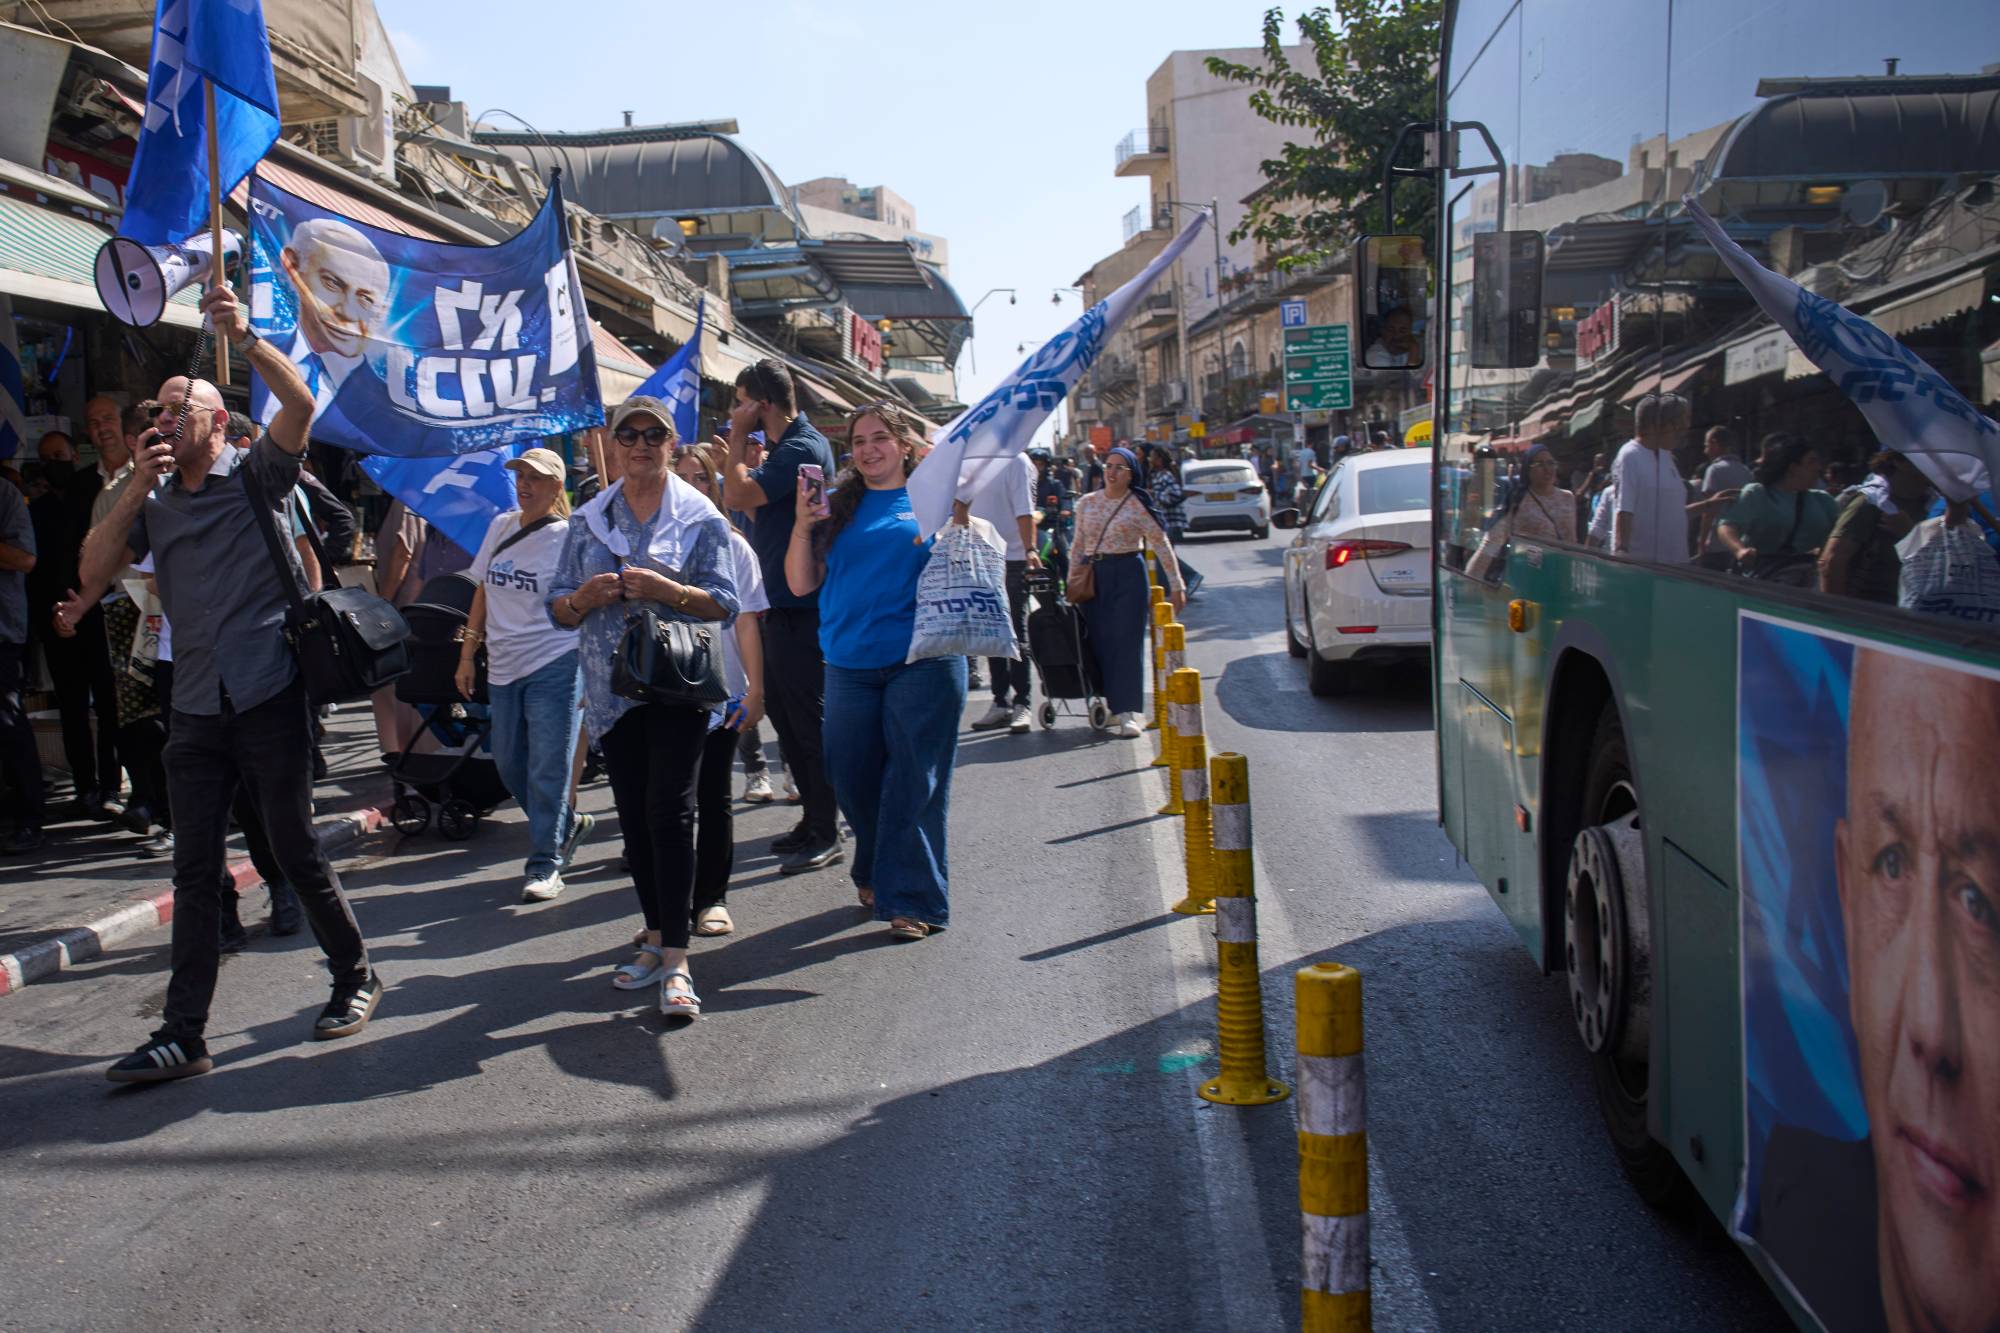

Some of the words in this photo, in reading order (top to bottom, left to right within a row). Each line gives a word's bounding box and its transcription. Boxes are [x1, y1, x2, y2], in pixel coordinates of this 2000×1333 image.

[1290, 307, 1300, 324] P
[1413, 434, 1431, 442] TAX
[930, 591, 1001, 614] הליכוד
